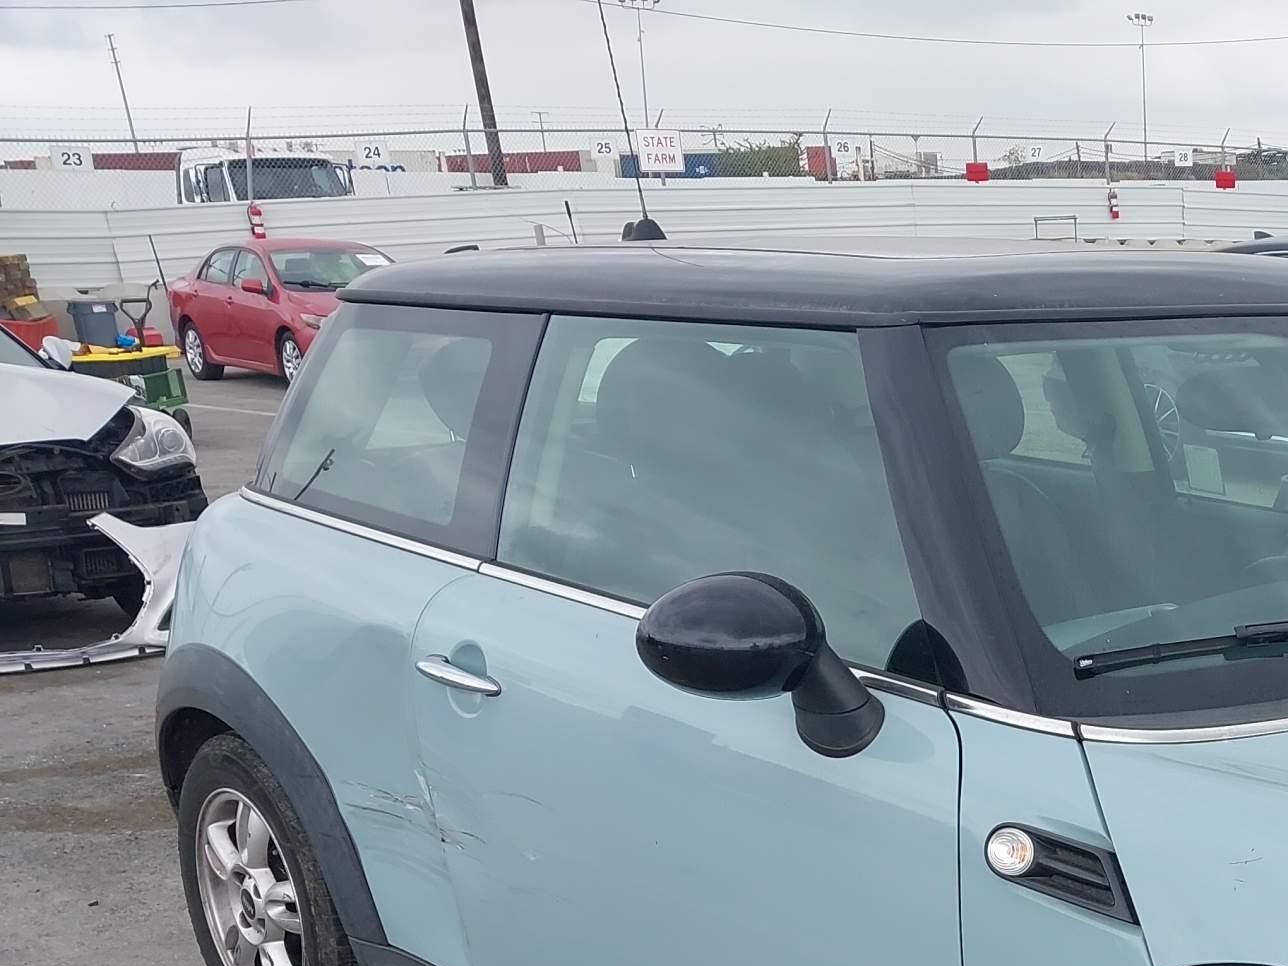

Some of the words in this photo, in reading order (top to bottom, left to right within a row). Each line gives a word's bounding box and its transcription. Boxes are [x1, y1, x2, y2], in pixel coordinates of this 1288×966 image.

[597, 142, 612, 154] 25
[643, 136, 676, 148] STATE
[836, 141, 850, 153] 26
[363, 146, 381, 159] 24
[647, 153, 677, 164] FARM
[1031, 147, 1042, 158] 27
[1179, 152, 1189, 162] 28
[61, 152, 83, 166] 23
